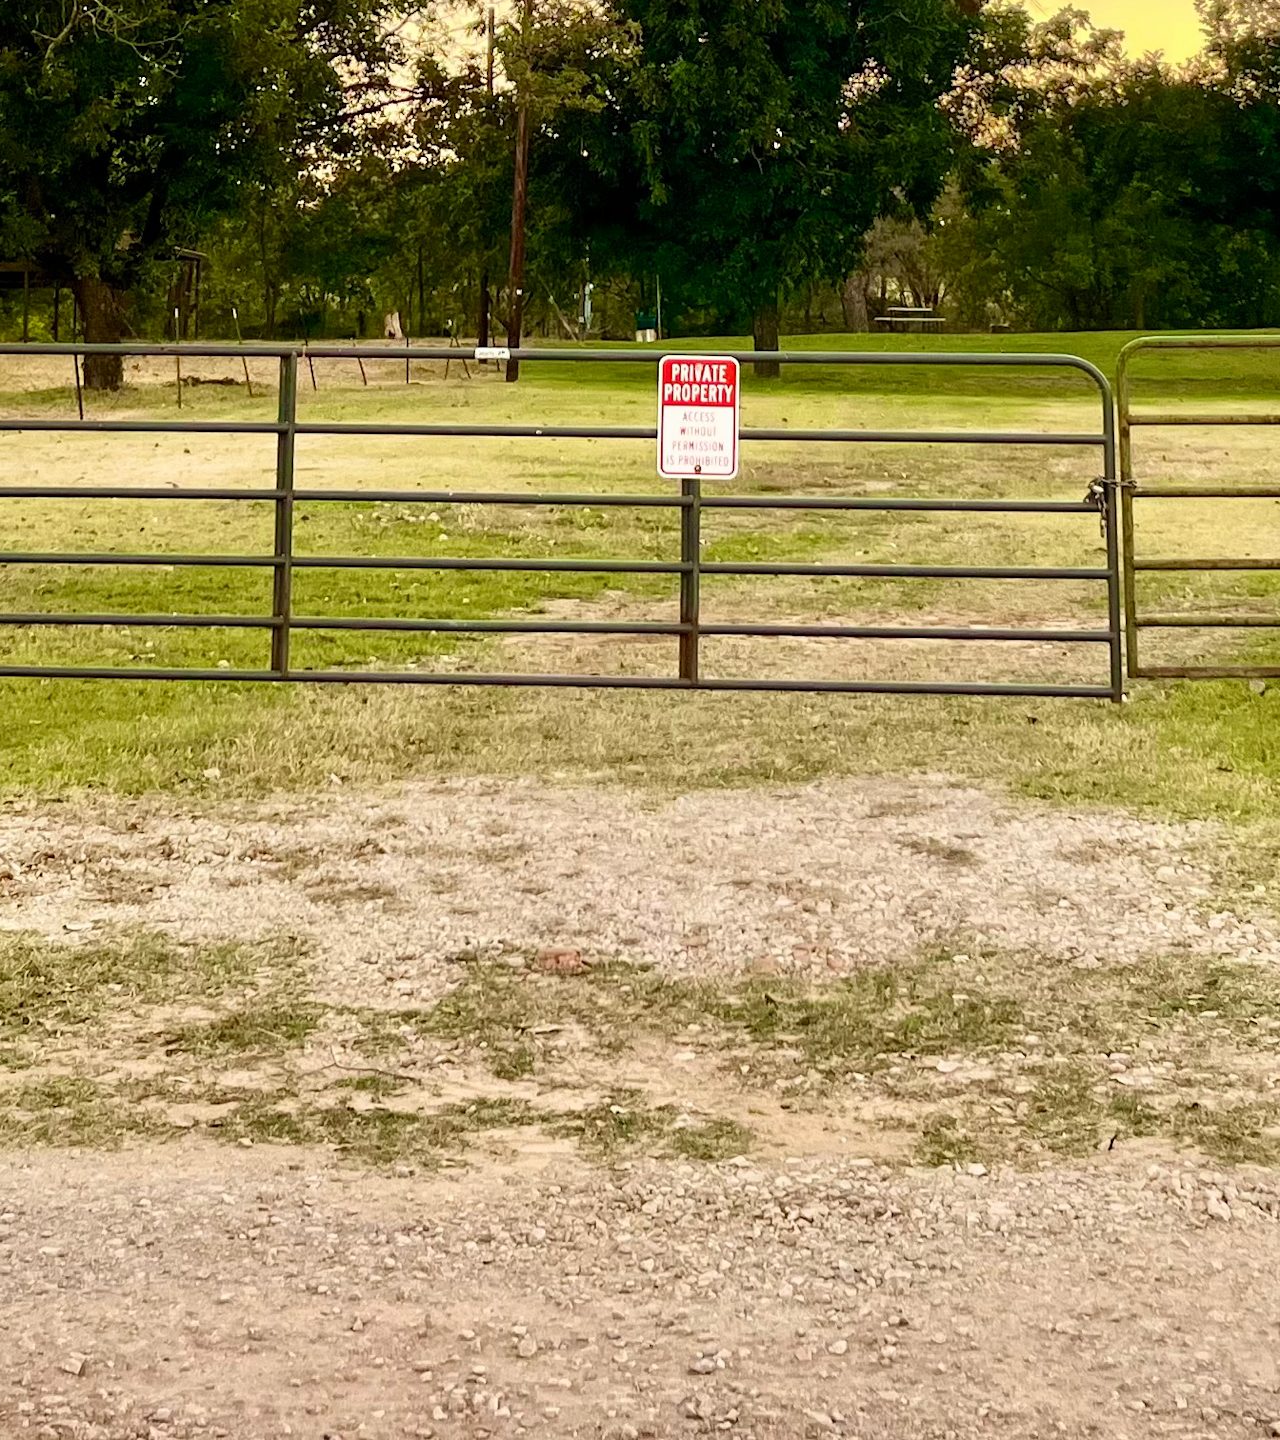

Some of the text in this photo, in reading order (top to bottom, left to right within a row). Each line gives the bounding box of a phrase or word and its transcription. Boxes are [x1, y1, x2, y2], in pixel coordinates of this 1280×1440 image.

[671, 363, 728, 383] PRIVATE
[664, 383, 734, 403] PROPERTY
[682, 411, 716, 423] ACCESS
[680, 426, 717, 437] WITHOUT
[672, 440, 724, 452] PERMISSION
[666, 455, 729, 467] IS PROHIBITED
